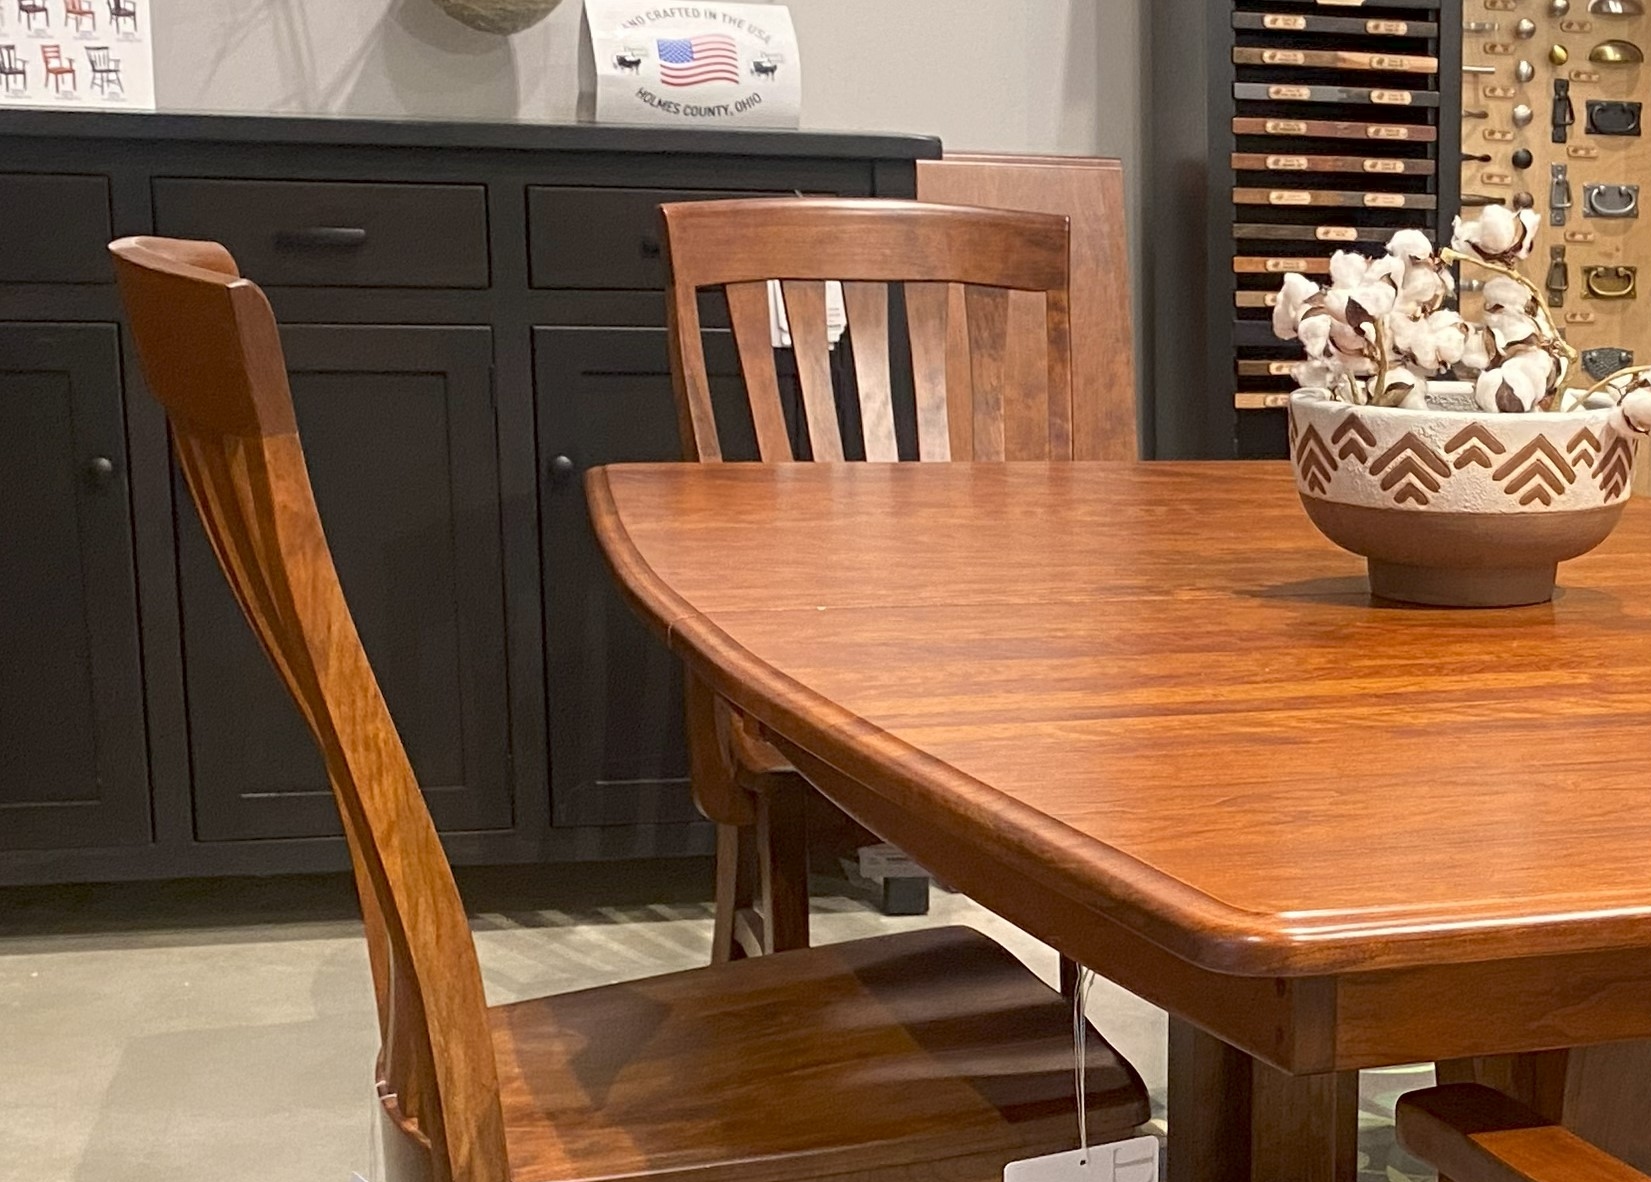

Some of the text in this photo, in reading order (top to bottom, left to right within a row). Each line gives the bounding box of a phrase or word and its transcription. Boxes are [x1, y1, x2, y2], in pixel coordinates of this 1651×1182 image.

[647, 7, 700, 21] CRAFTED
[704, 10, 717, 20] IN
[722, 14, 746, 28] THE
[747, 24, 772, 44] USA
[635, 87, 680, 116] HOLMES
[736, 92, 763, 113] OHIO
